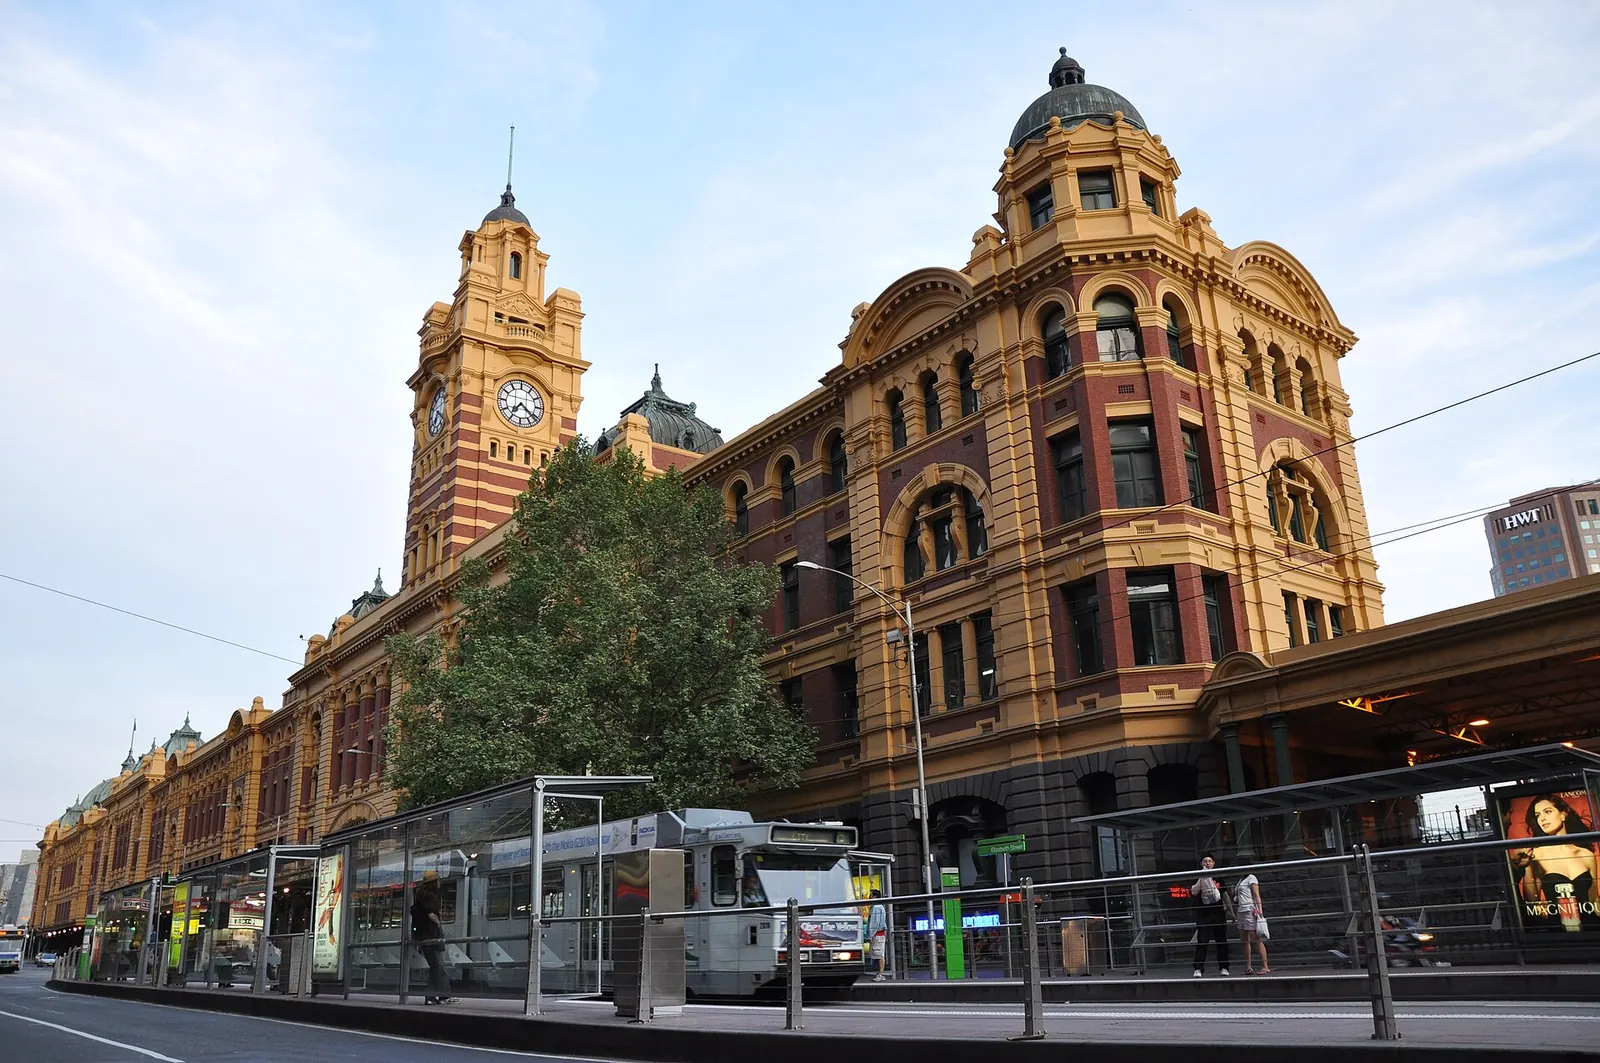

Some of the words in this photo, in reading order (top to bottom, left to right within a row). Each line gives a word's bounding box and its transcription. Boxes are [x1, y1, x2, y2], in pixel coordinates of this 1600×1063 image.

[1504, 508, 1540, 530] HWT
[1560, 789, 1587, 798] LANCÔM
[639, 826, 655, 834] NOKIA
[990, 845, 1010, 853] Elizabeth
[821, 922, 836, 931] The
